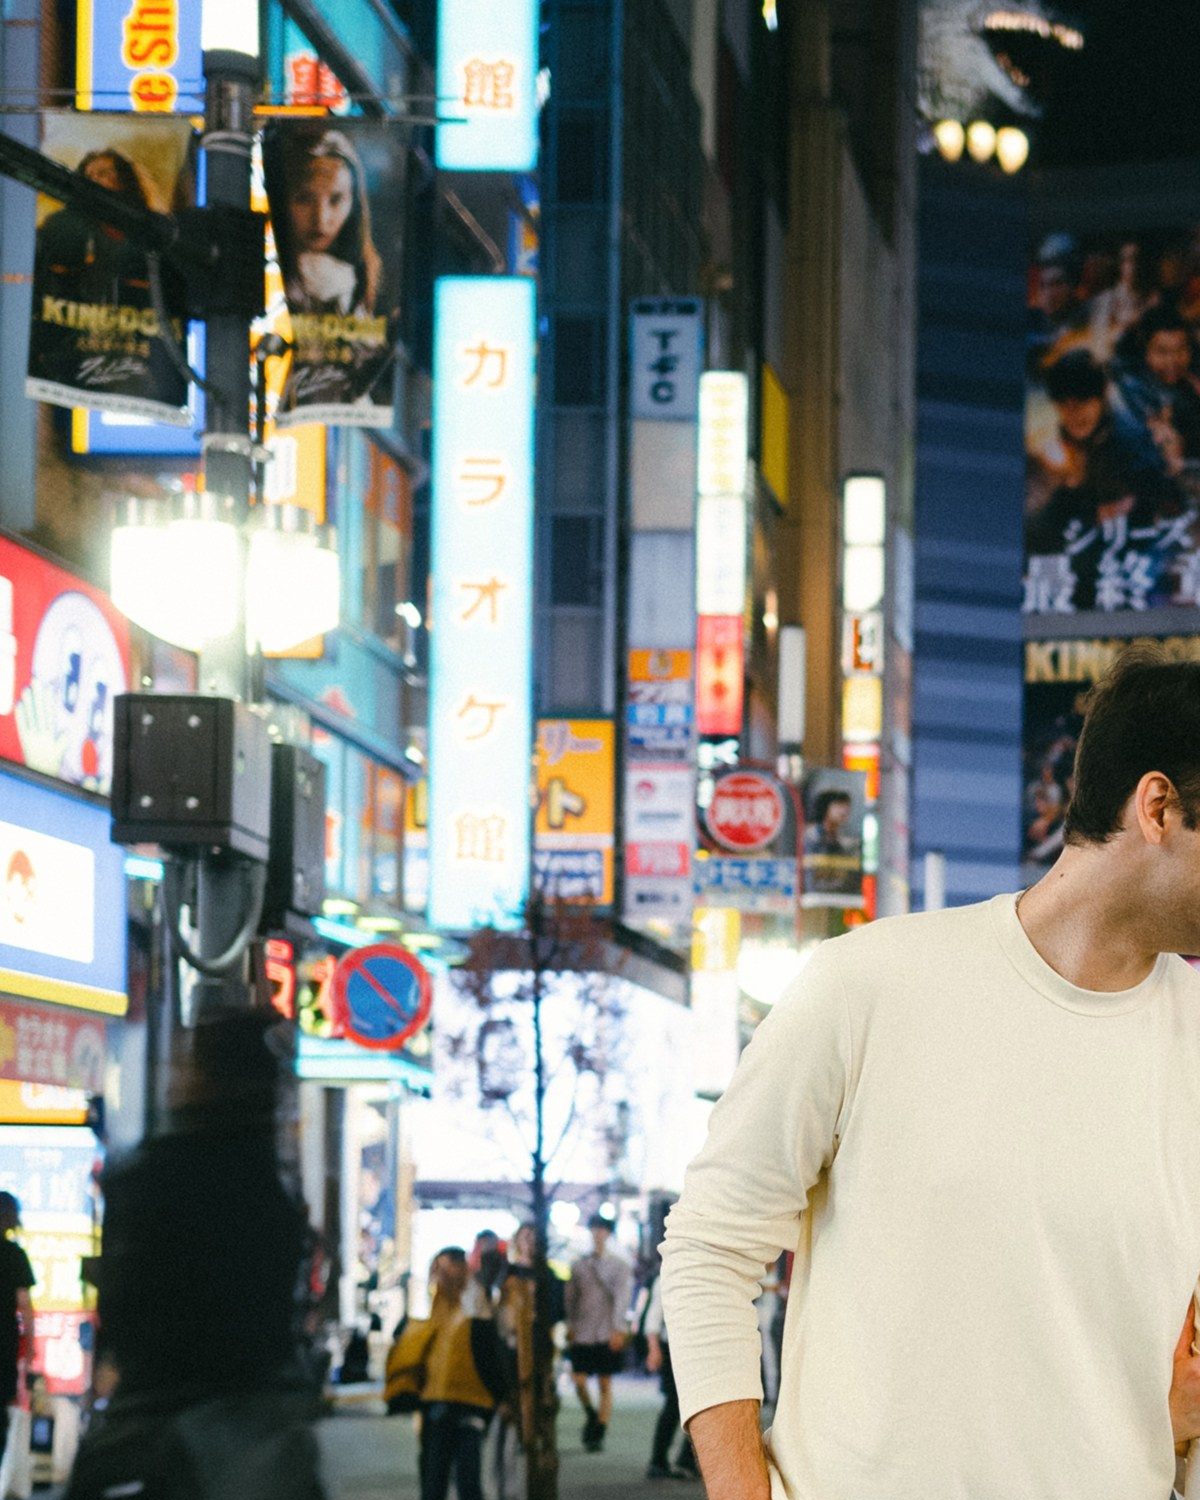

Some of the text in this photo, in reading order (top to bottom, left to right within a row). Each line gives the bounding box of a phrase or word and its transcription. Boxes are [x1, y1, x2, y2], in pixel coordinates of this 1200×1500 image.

[464, 58, 514, 110] 館
[455, 339, 508, 866] カラオケ館
